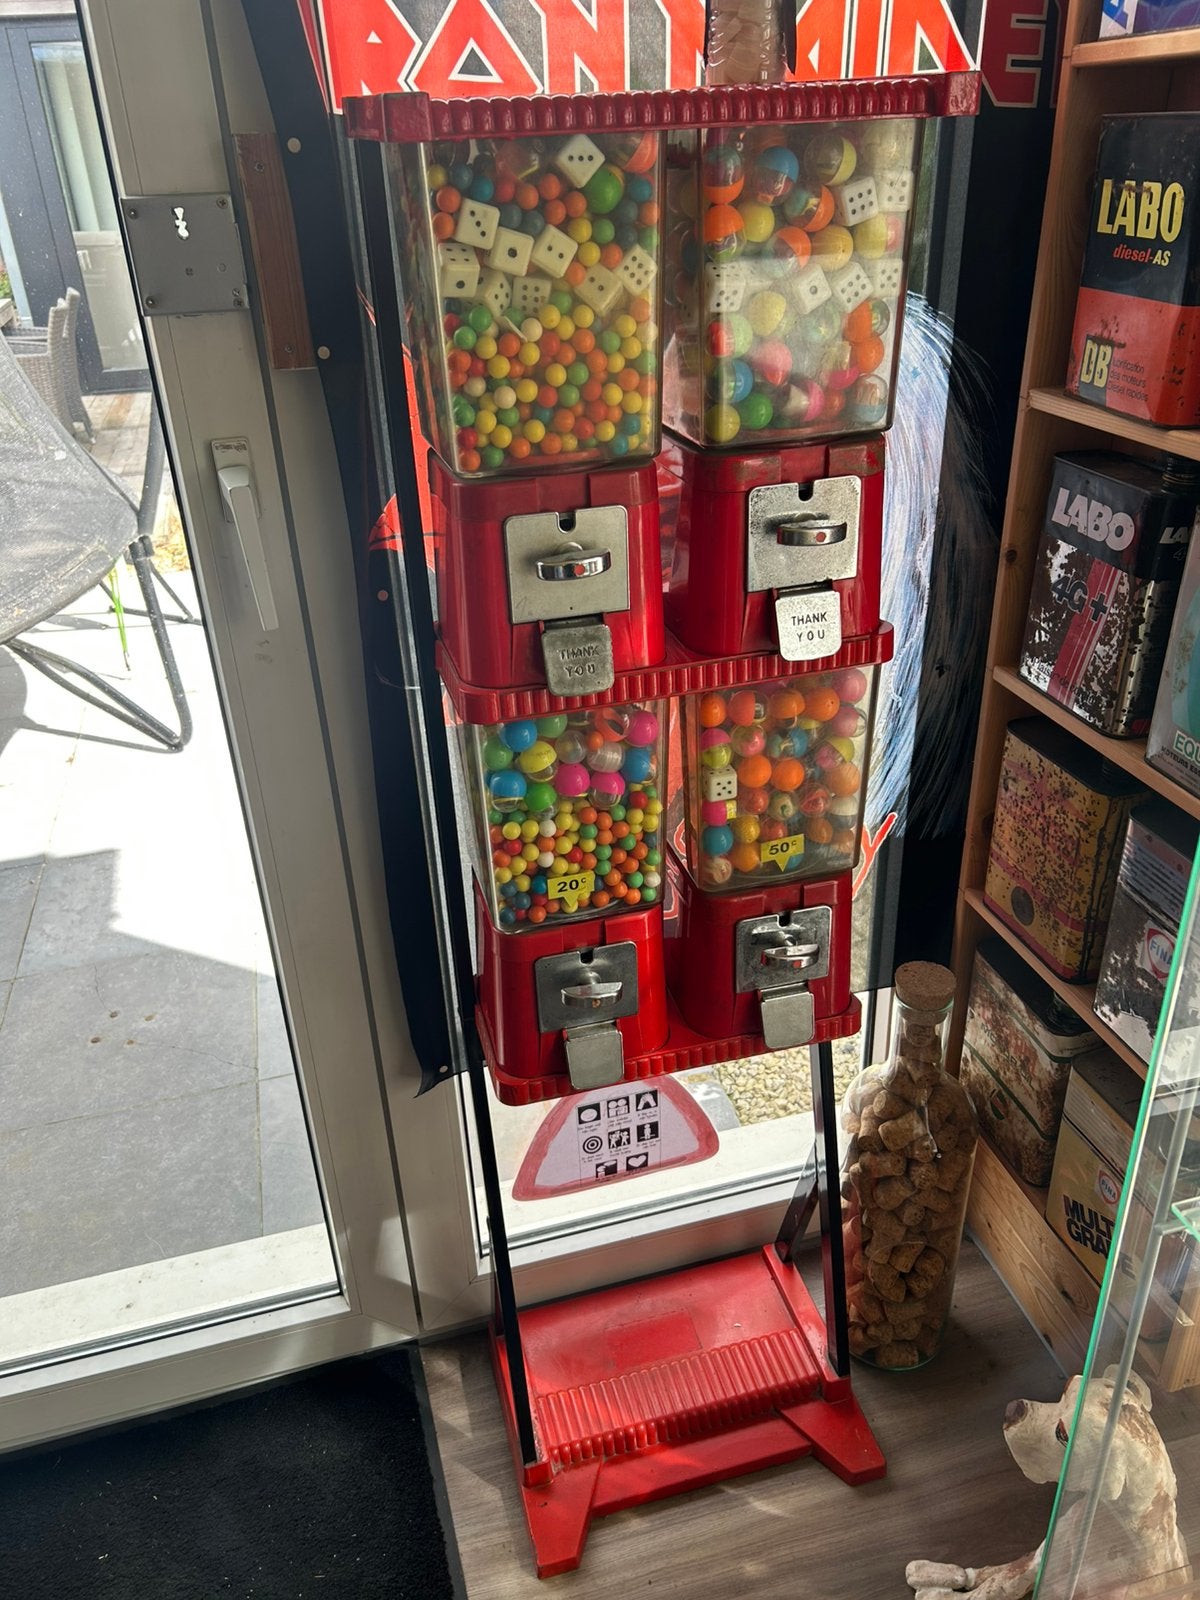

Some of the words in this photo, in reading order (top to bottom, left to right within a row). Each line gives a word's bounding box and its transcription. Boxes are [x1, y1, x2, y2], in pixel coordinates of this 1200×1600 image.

[1096, 178, 1185, 243] LABO
[1112, 244, 1171, 267] diesel-AS
[1080, 339, 1112, 388] DB
[1051, 487, 1135, 551] LABO
[1159, 526, 1191, 544] LA
[791, 611, 828, 626] THANK
[796, 629, 825, 642] YOU
[558, 644, 600, 660] THANK
[564, 663, 596, 678] YOU
[1063, 1194, 1115, 1241] MULT
[1066, 1217, 1136, 1280] GRAE
